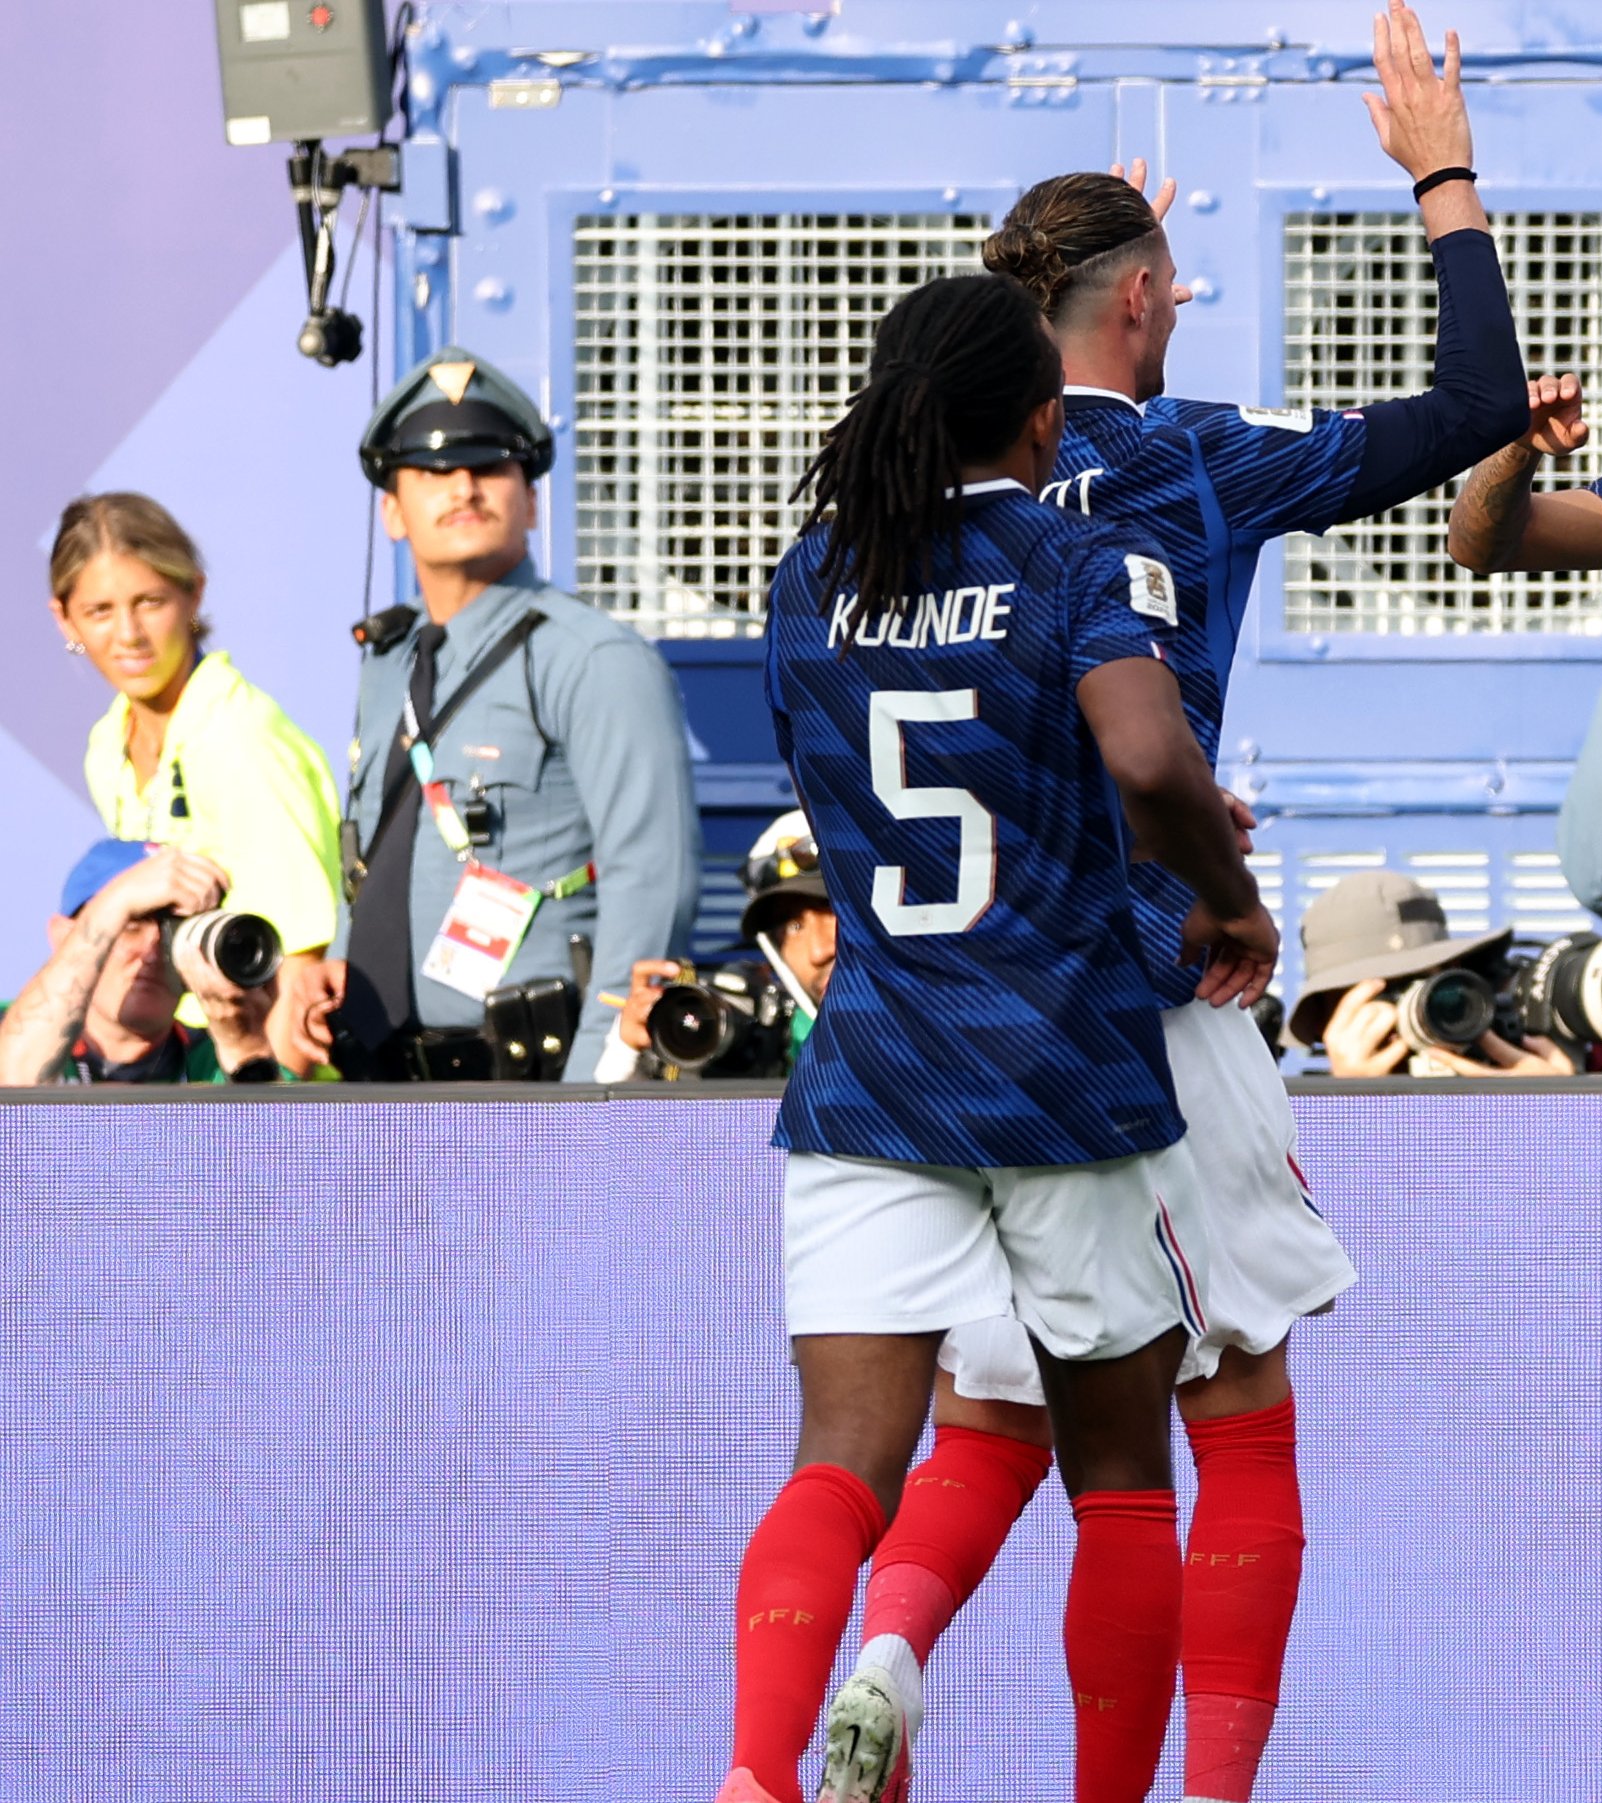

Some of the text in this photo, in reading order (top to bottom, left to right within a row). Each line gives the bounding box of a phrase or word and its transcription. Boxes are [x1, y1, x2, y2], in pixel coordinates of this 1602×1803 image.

[869, 688, 998, 936] 5
[1190, 1552, 1261, 1567] FFF
[749, 1608, 815, 1632] FFF
